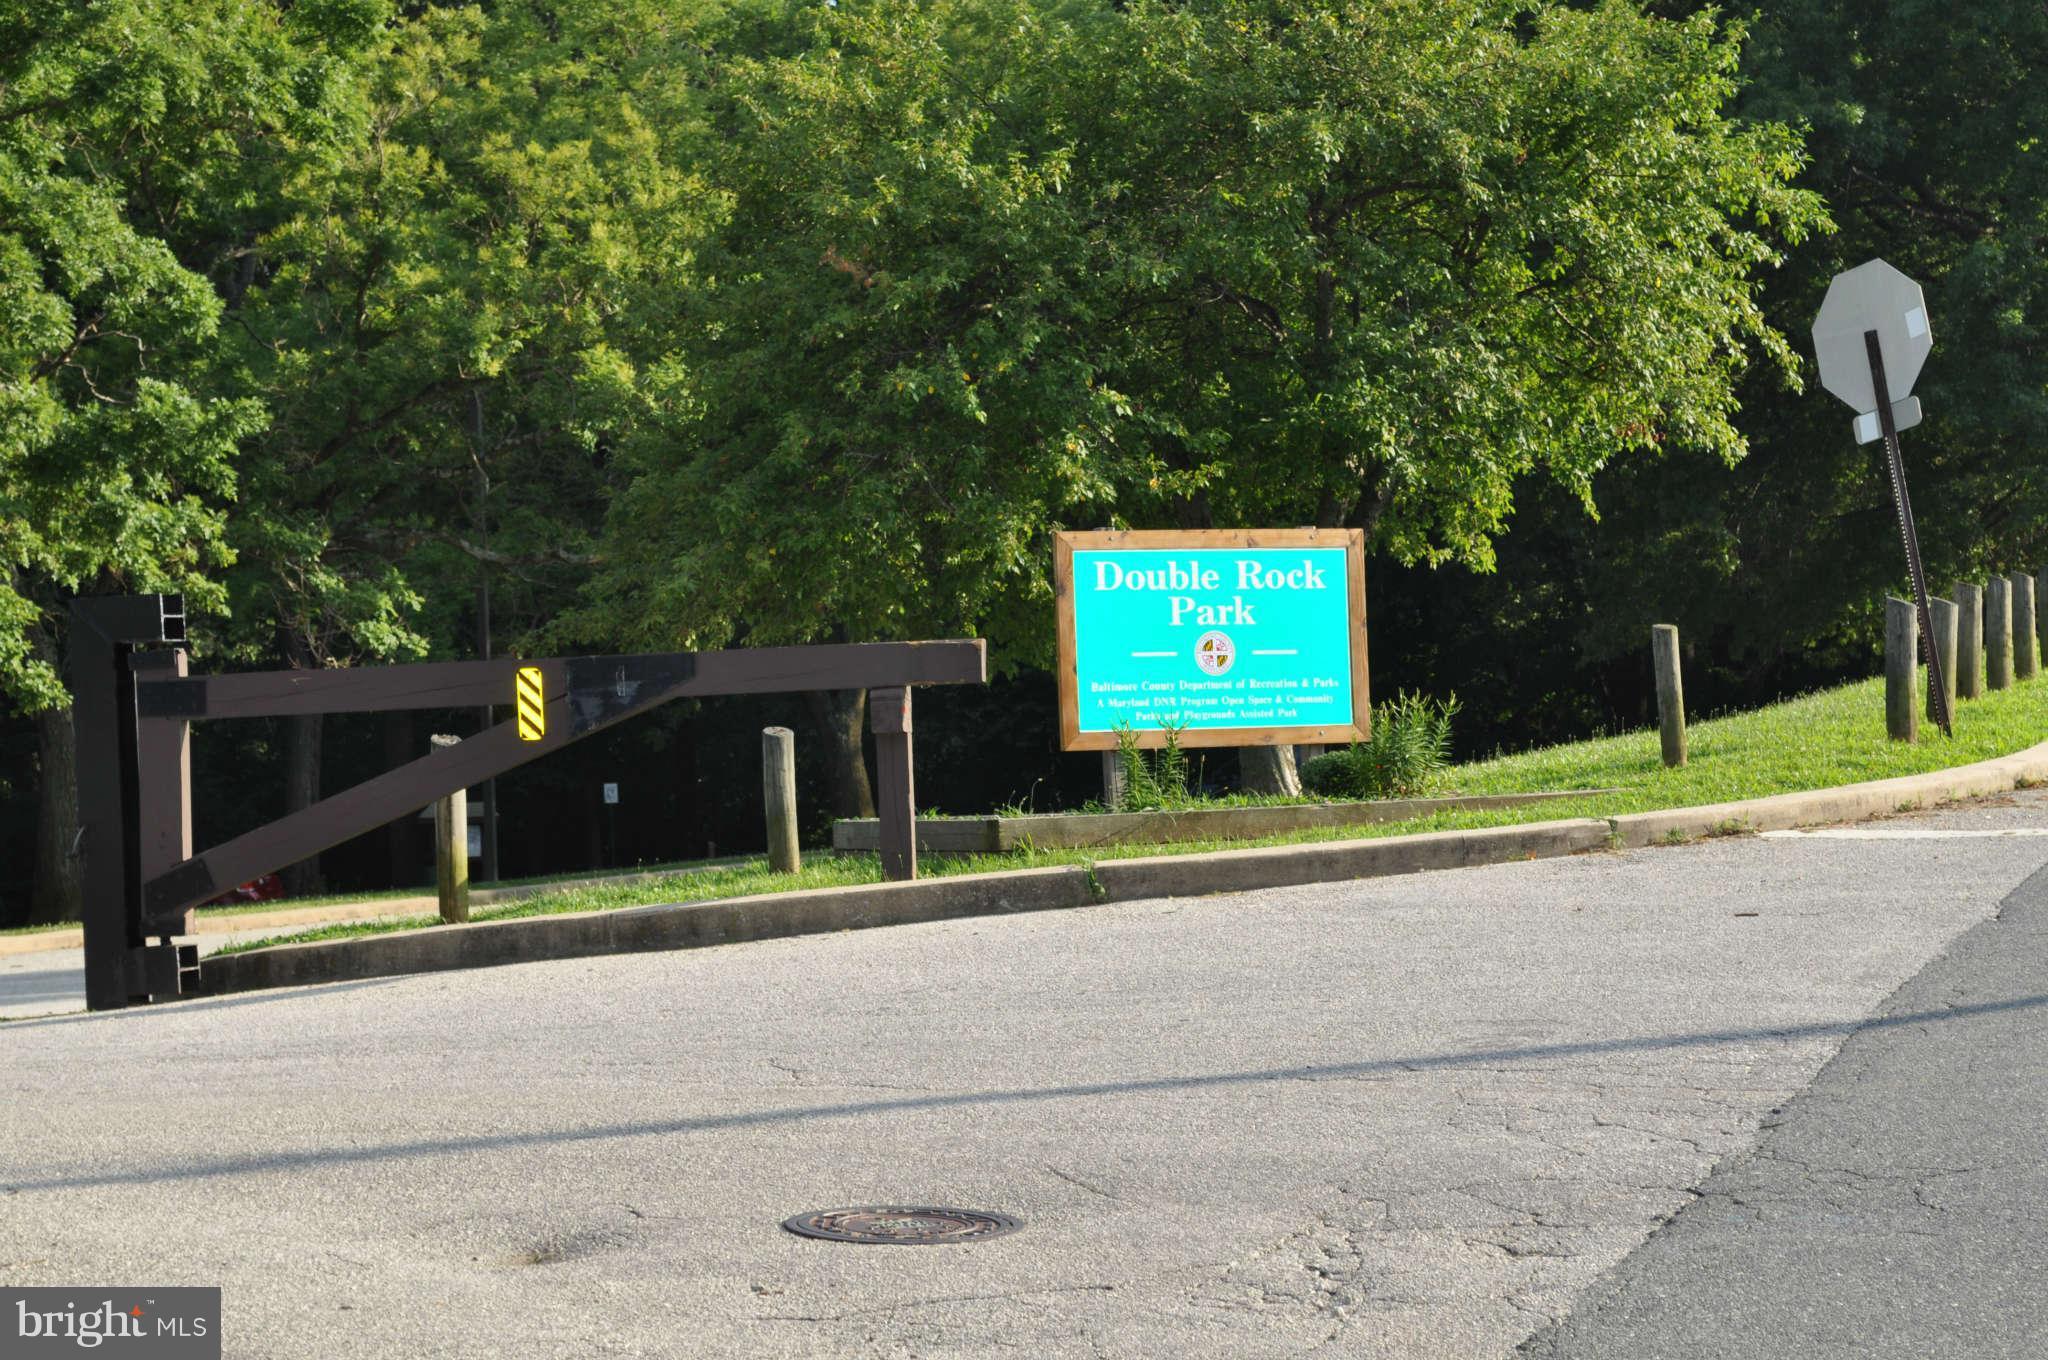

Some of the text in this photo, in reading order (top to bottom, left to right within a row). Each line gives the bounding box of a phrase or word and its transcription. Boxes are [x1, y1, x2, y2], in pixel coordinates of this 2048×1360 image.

[1093, 560, 1326, 591] Double Rock
[1168, 596, 1256, 626] Park
[1091, 678, 1339, 692] Baltimore County Department of Recreation & Parks
[1097, 694, 1333, 708] A Maryland DNR Program Open Space & Community
[1184, 710, 1235, 721] Playgrounds
[1240, 710, 1274, 718] Assisted
[1278, 708, 1297, 717] Park
